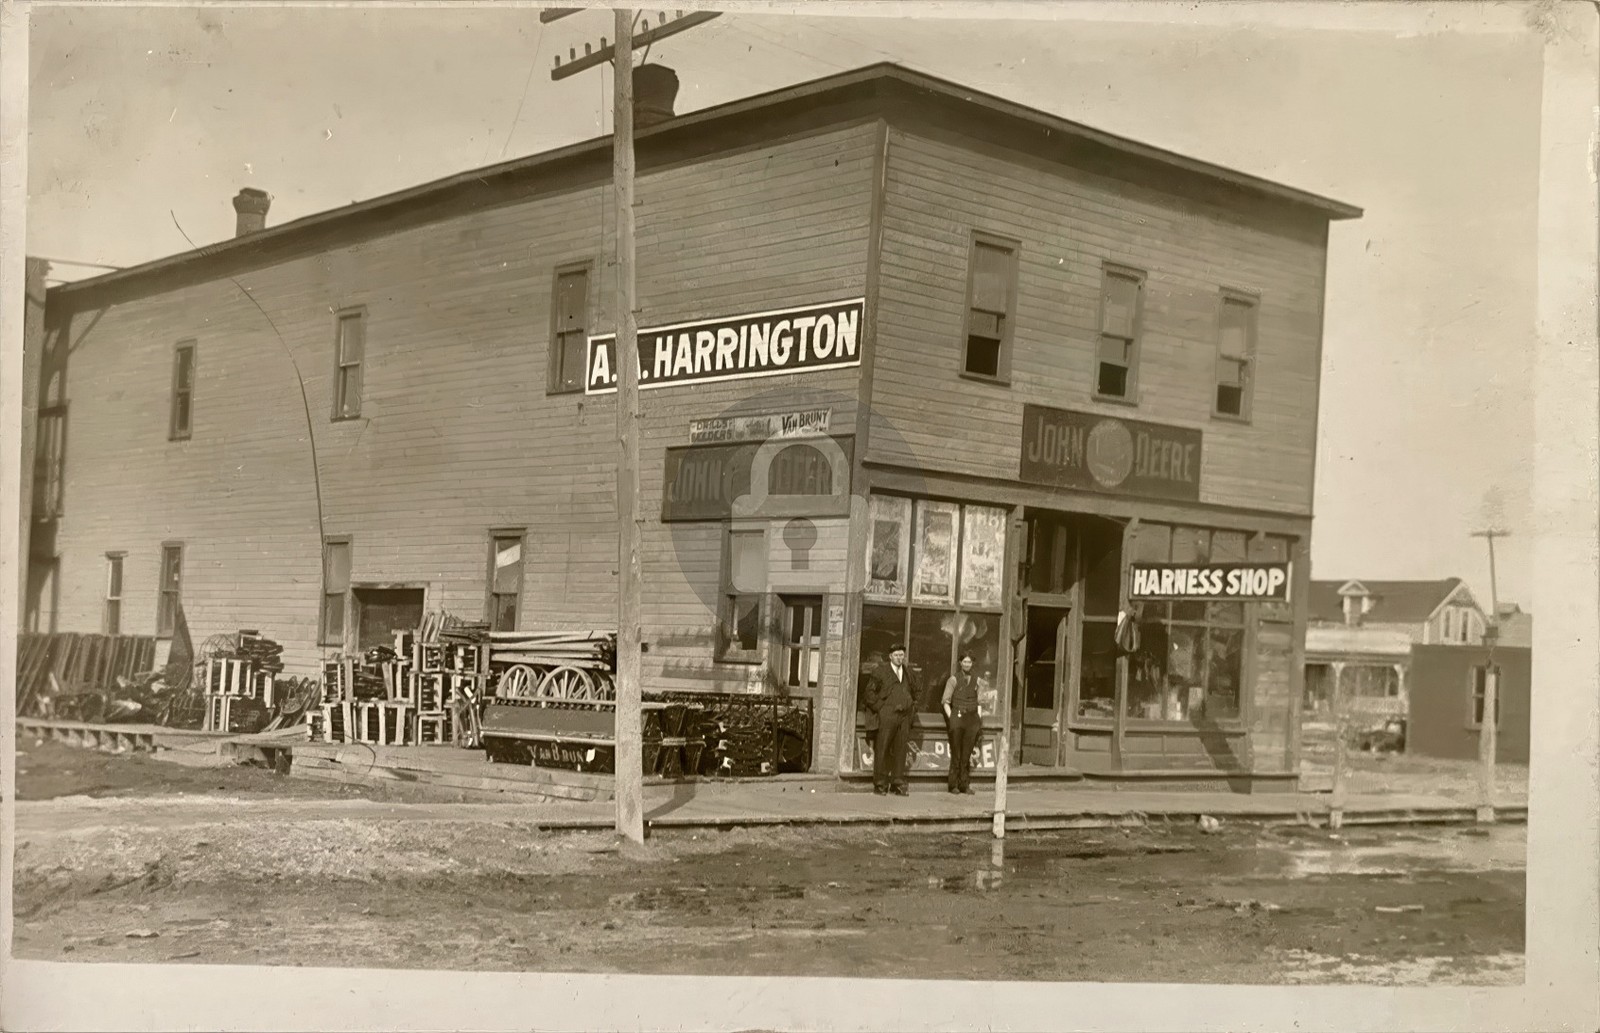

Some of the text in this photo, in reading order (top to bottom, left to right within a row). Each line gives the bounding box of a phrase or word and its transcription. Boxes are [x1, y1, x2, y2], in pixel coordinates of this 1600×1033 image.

[590, 343, 617, 386] A.
[653, 309, 859, 378] HARRINGTON
[1028, 415, 1198, 482] JOHN DEERE
[1133, 567, 1285, 596] HARNESS SHOP
